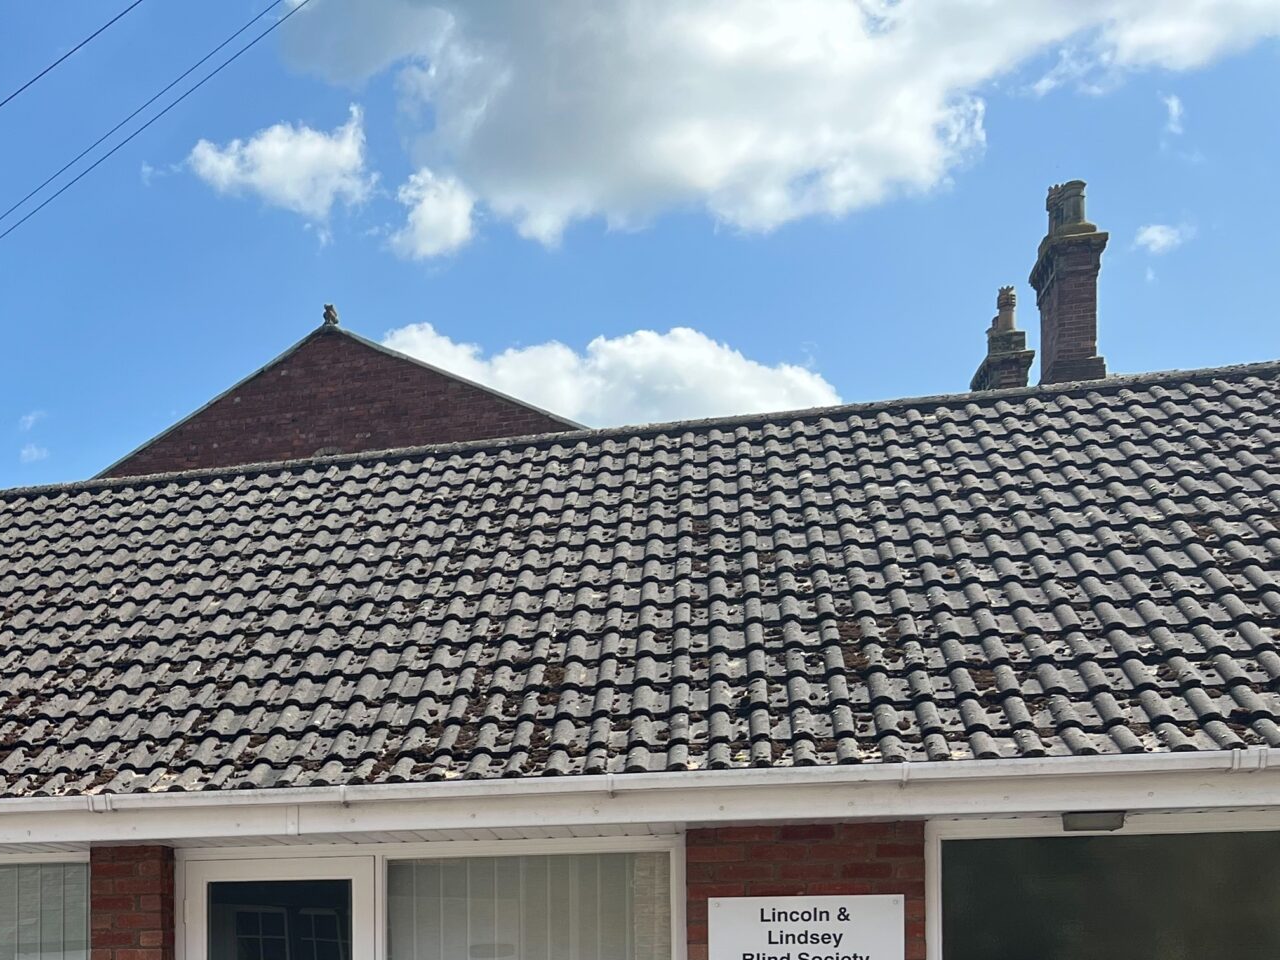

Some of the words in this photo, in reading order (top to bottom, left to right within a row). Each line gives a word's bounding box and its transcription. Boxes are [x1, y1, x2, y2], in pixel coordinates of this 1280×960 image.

[760, 907, 830, 923] Lincoln
[837, 907, 851, 922] &
[768, 930, 843, 948] Lindsey
